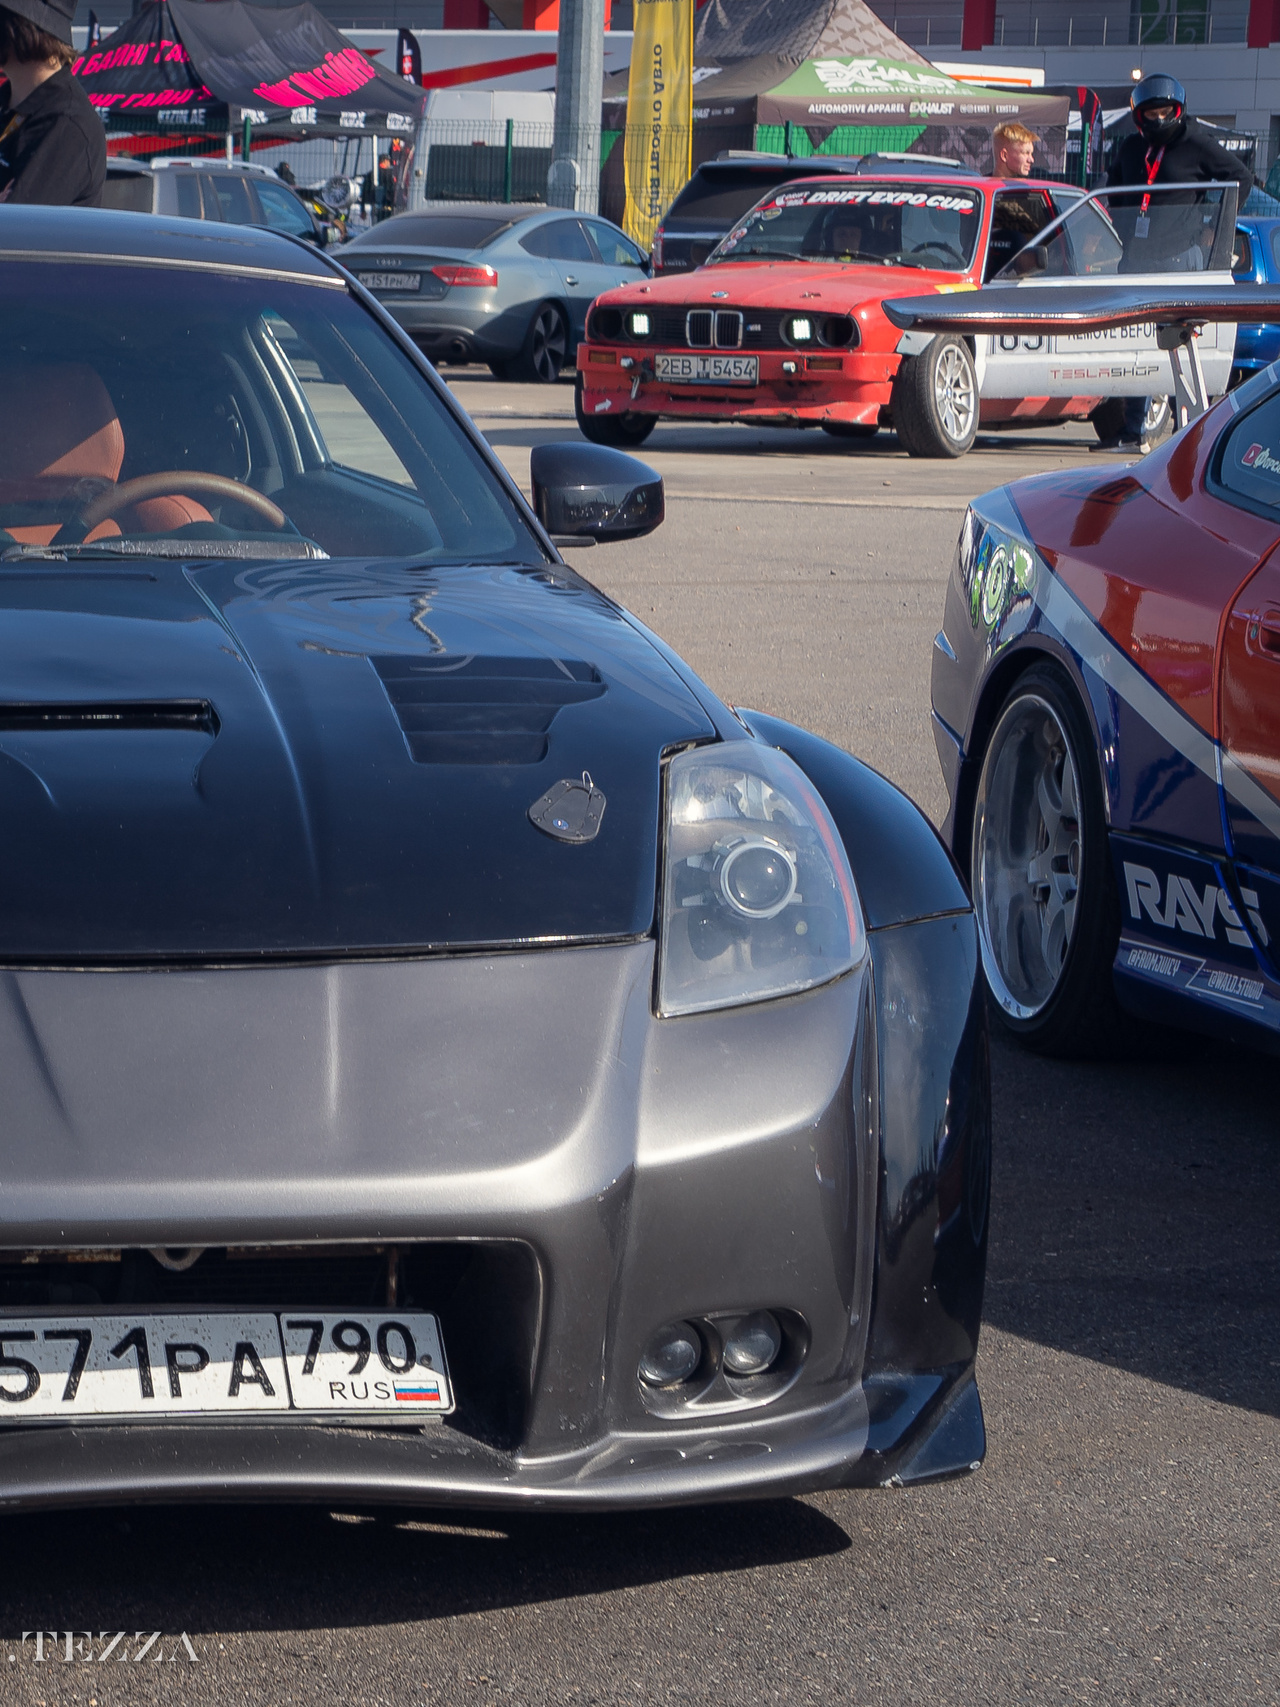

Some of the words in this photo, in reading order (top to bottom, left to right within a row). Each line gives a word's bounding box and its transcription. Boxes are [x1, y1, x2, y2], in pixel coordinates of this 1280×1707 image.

[812, 60, 958, 88] EXHAUST
[808, 102, 866, 114] AUTOMOTIVE
[867, 102, 906, 113] APPAREL
[909, 101, 955, 115] EXHAUST
[807, 191, 870, 203] DRIFT
[867, 192, 927, 205] EXPO
[926, 195, 974, 211] CUP
[661, 358, 692, 375] 2EB
[713, 359, 753, 377] 5454
[1050, 366, 1159, 379] TESLASHOP
[1123, 861, 1269, 949] RAYS
[1127, 948, 1181, 978] @FROMJUICY
[1207, 970, 1265, 1001] @WALD.STUDIO
[286, 1320, 416, 1376] 790
[330, 1381, 392, 1400] RUS
